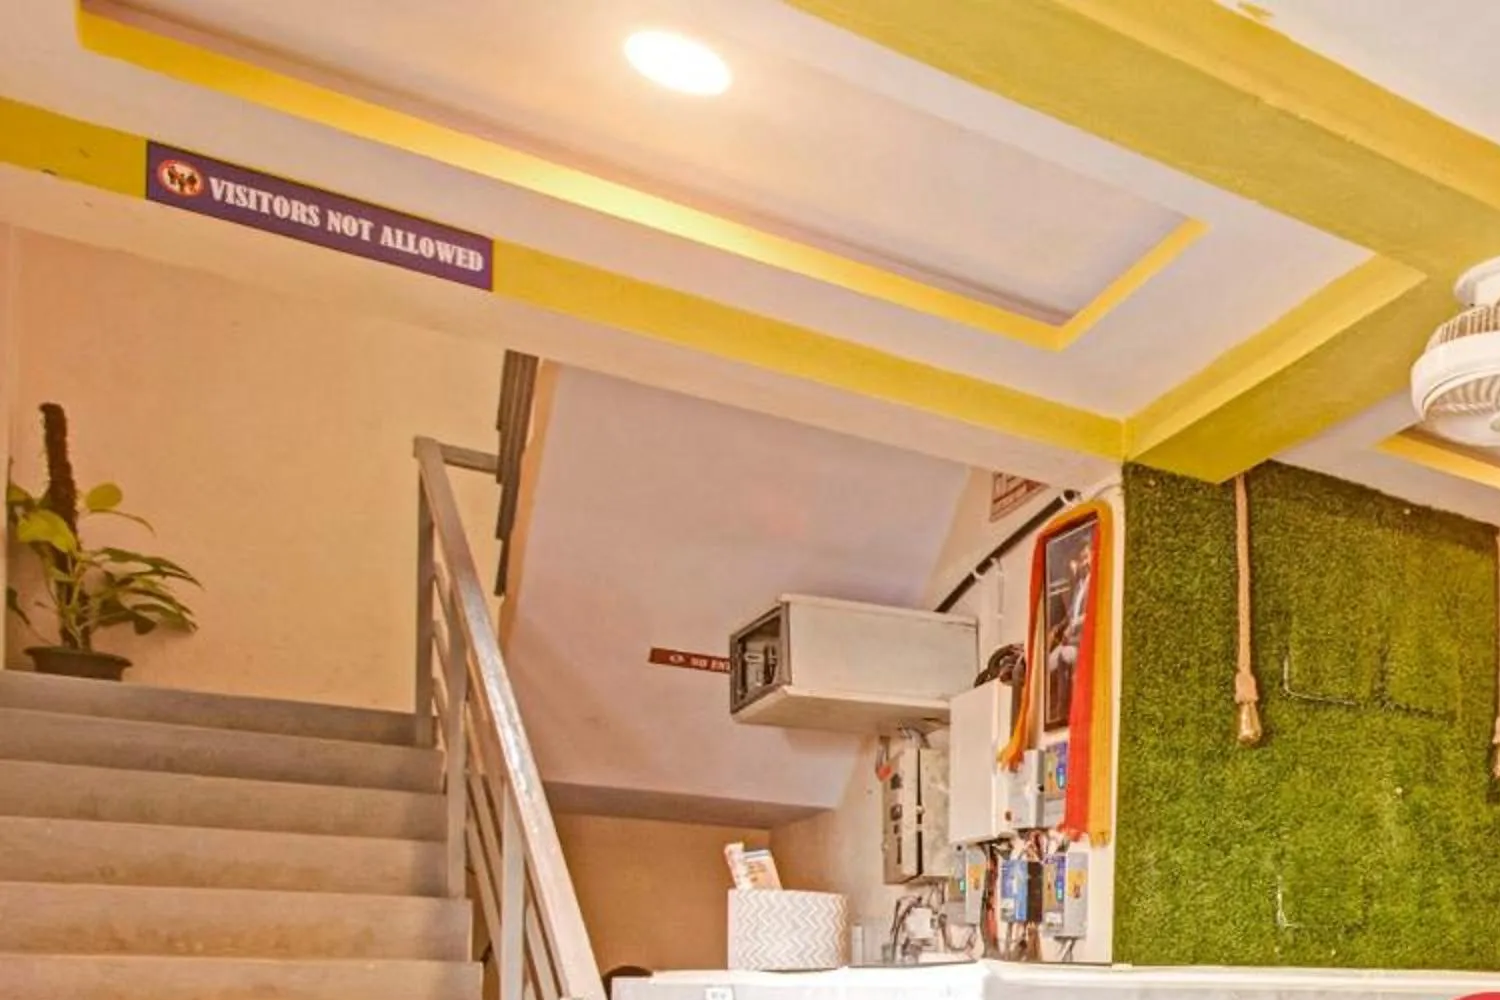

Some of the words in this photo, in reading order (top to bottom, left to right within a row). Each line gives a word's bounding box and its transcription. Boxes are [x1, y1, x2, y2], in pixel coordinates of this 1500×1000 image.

[209, 177, 321, 228] VISITORS
[327, 210, 374, 242] NOT
[380, 224, 484, 273] ALLOWED
